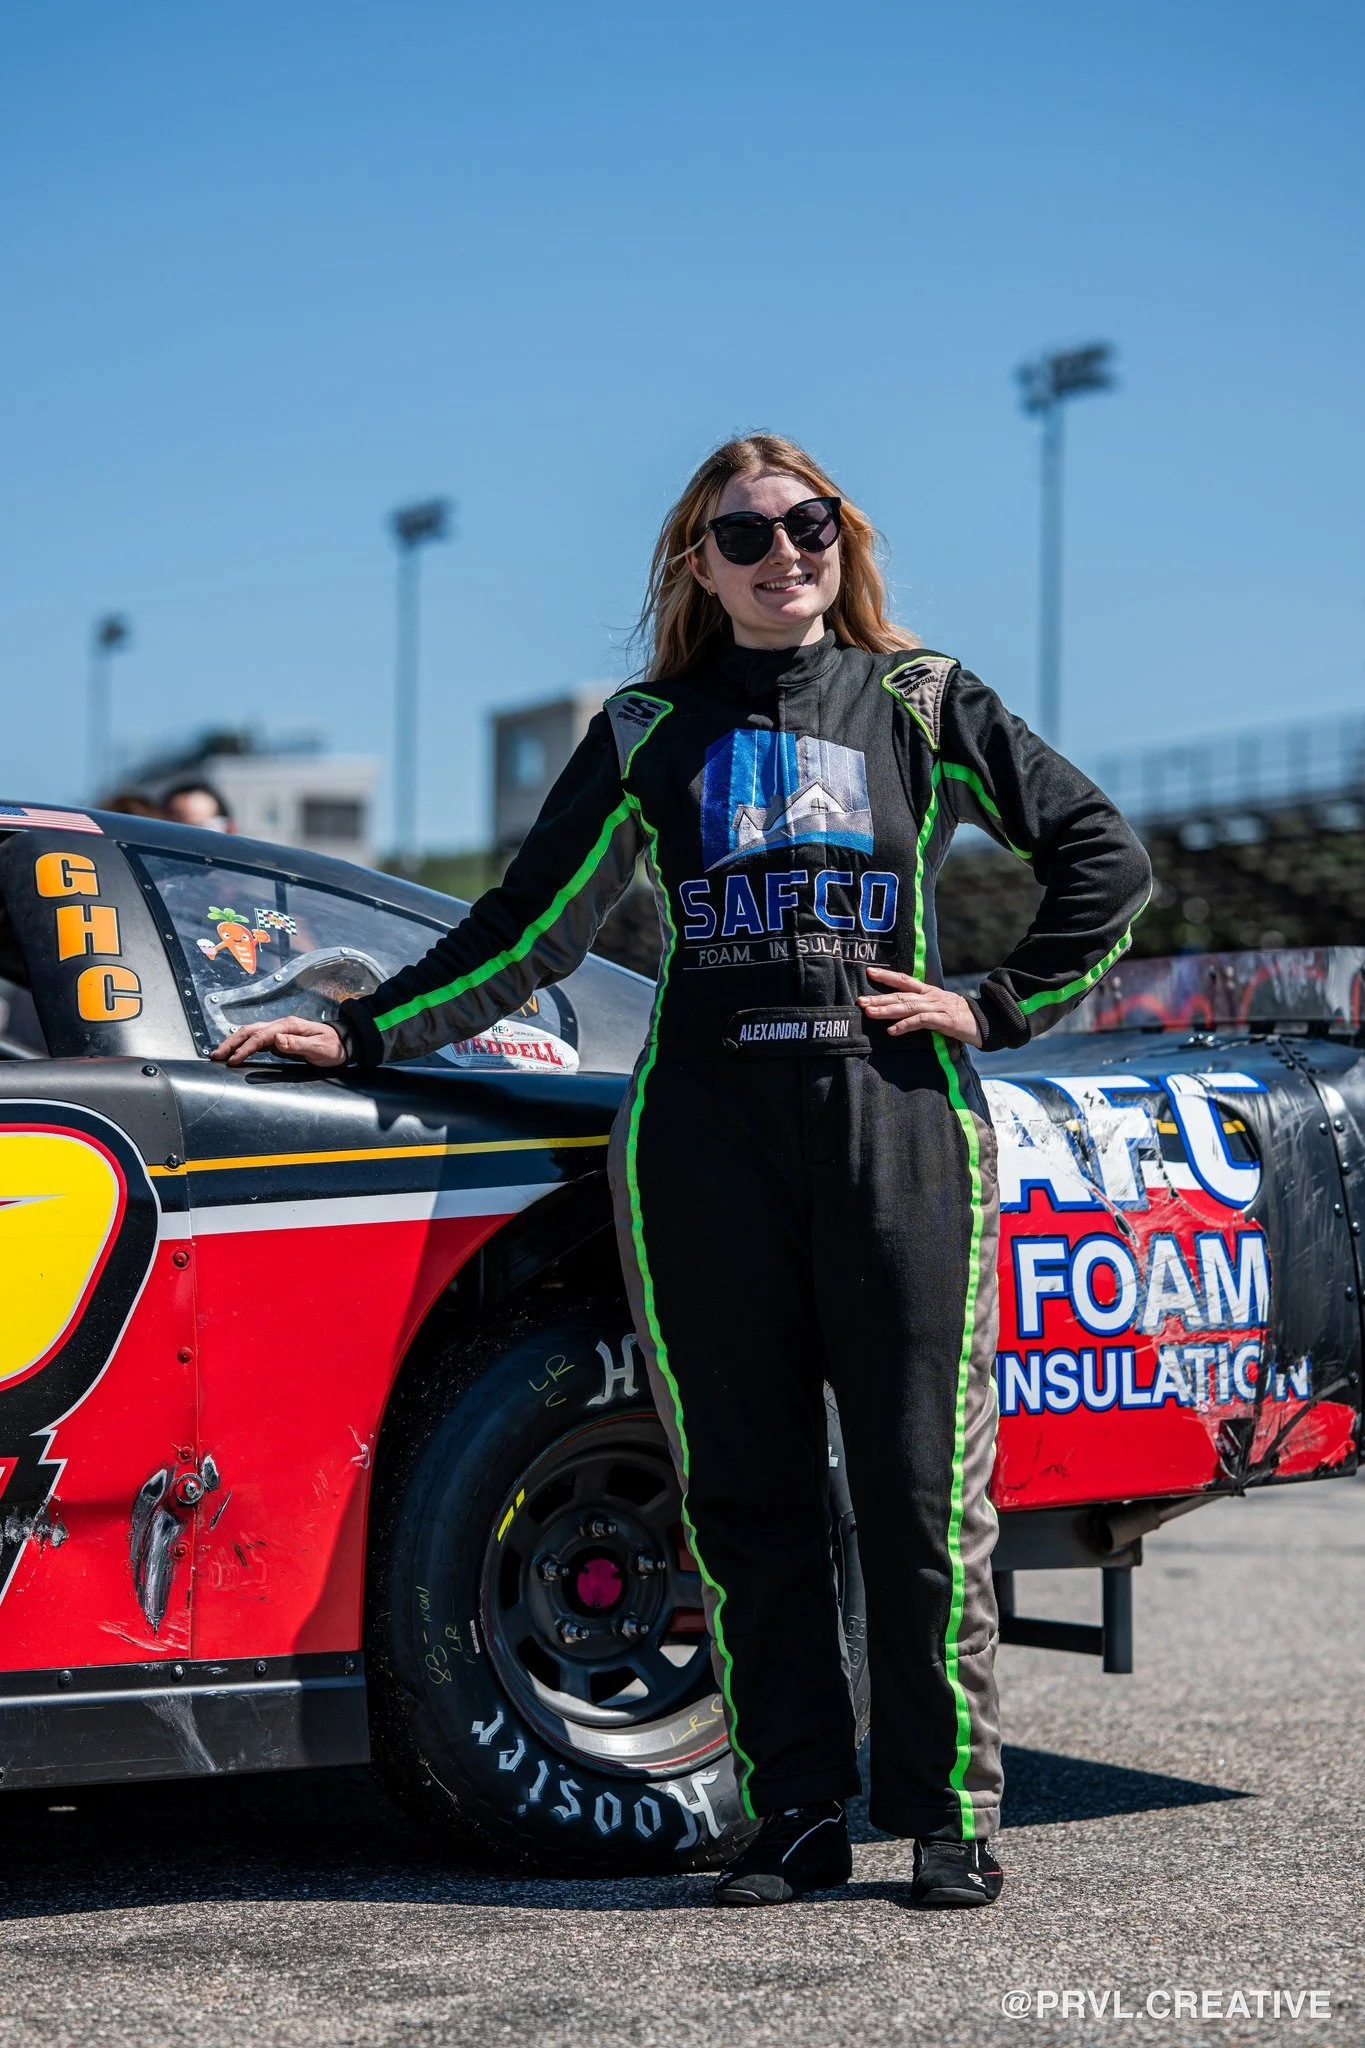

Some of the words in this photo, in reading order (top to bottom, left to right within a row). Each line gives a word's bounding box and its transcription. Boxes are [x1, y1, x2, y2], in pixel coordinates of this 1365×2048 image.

[679, 870, 899, 940] SAFCO
[699, 945, 753, 967] FOAM
[451, 1037, 564, 1067] WADDELL
[740, 1021, 808, 1041] ALEXANDRA
[812, 1019, 850, 1039] FEARN
[1011, 1228, 1273, 1340] FOAM
[470, 1710, 728, 1851] Hoosier
